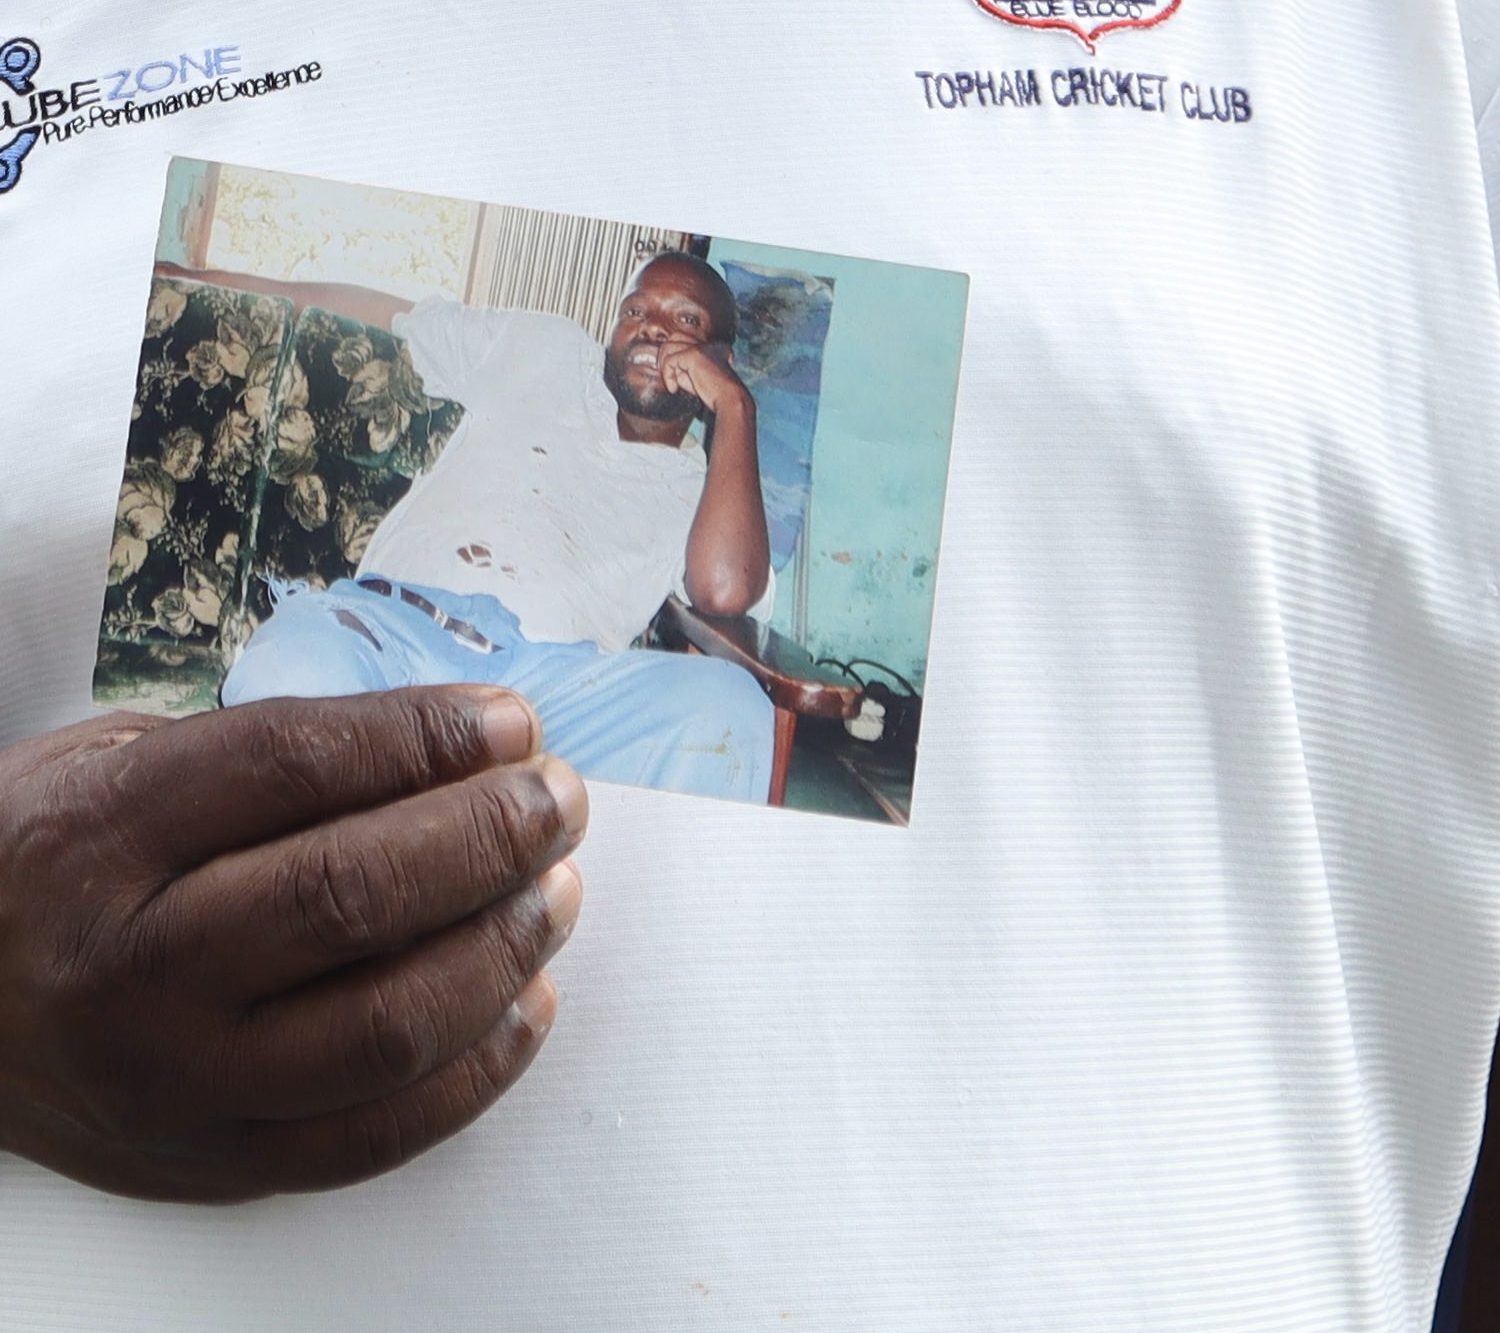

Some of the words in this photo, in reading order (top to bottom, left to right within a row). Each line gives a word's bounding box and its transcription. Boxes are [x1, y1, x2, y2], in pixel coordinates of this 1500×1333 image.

[1010, 2, 1065, 18] BLUE
[1074, 1, 1143, 20] BLOOD
[103, 45, 242, 101] ZONE
[916, 69, 1041, 109] TOPHAM
[1050, 68, 1168, 112] CRICKET
[1180, 81, 1253, 124] CLUB
